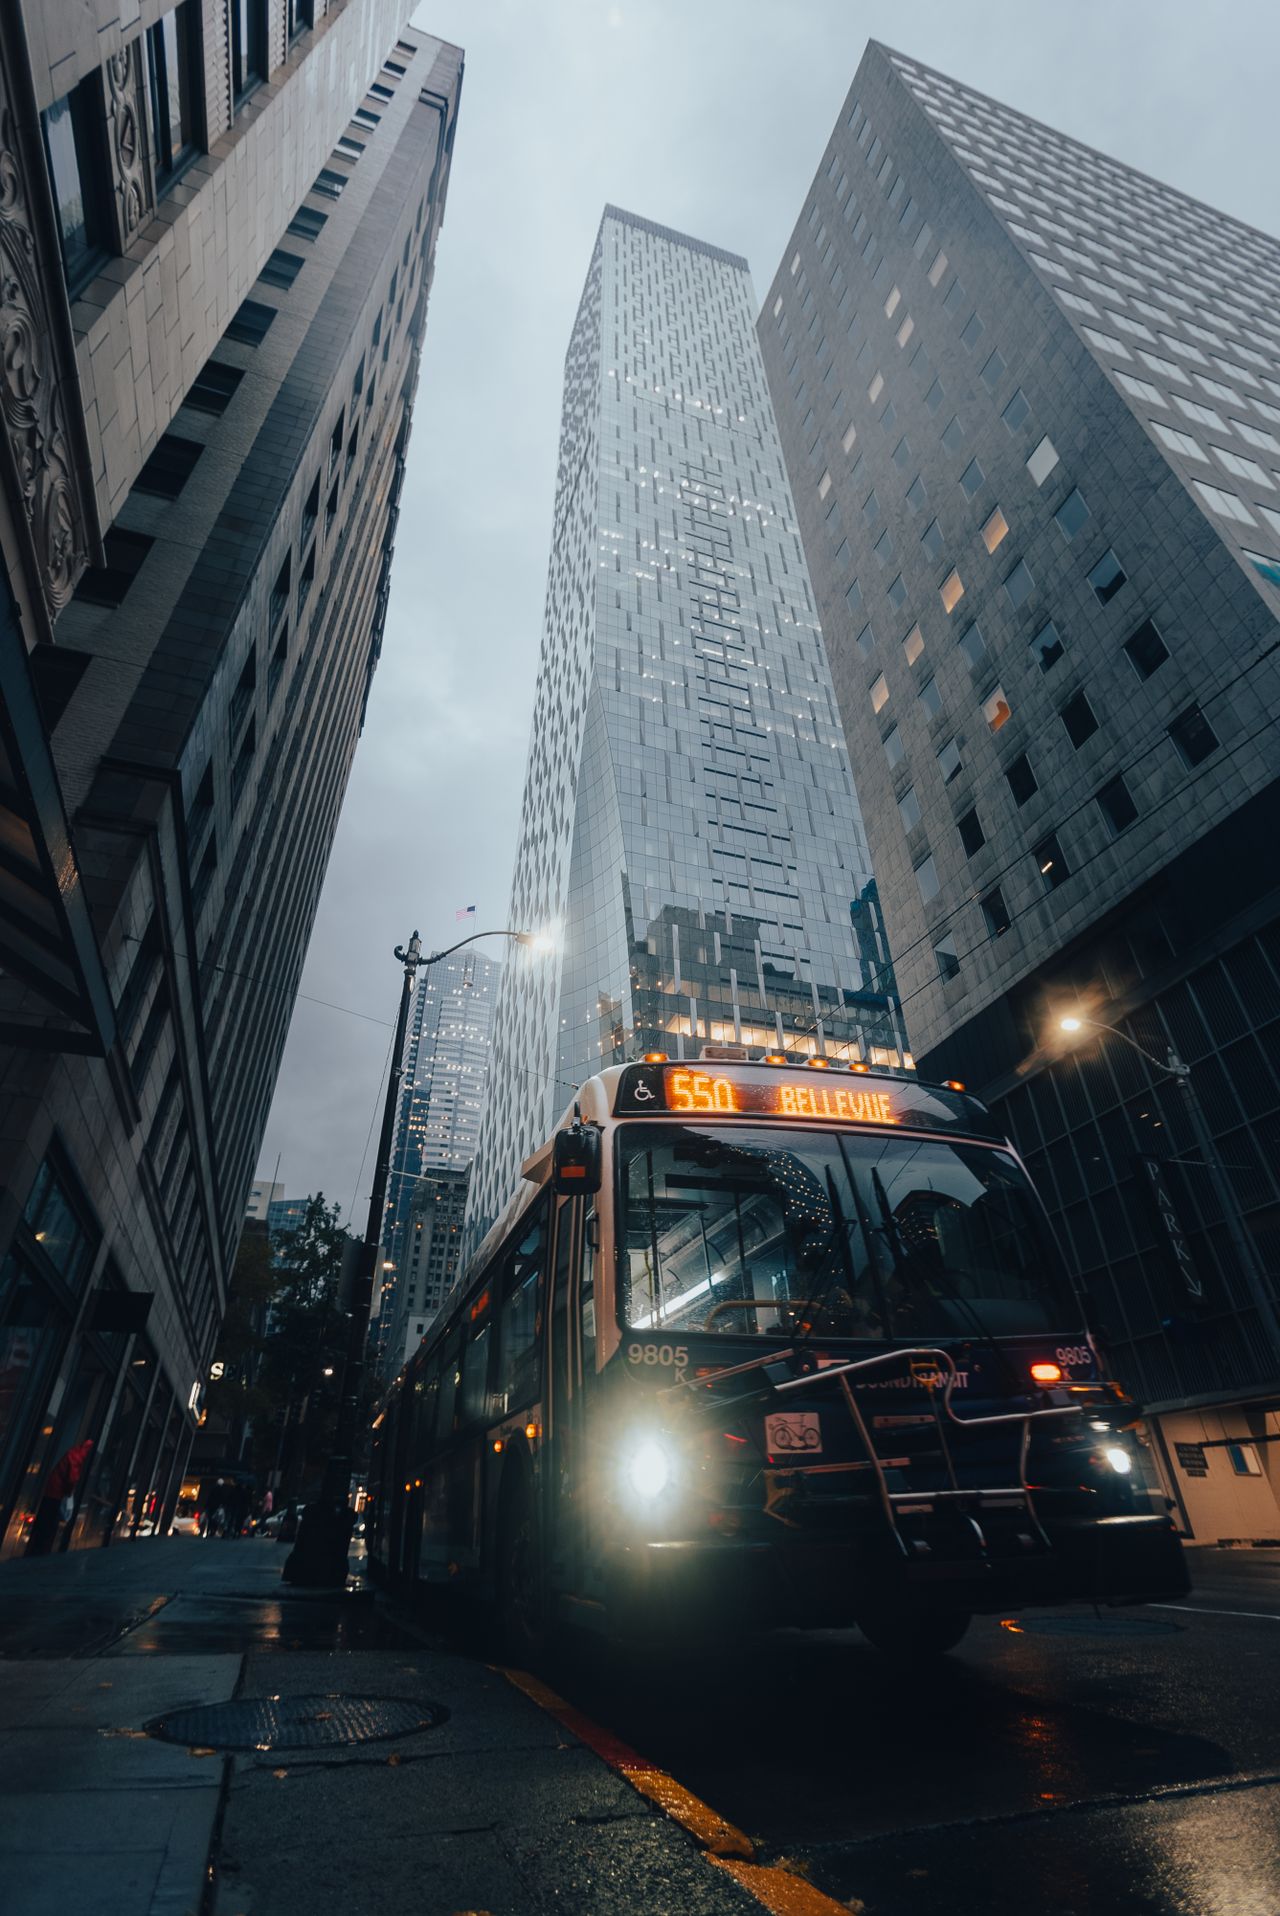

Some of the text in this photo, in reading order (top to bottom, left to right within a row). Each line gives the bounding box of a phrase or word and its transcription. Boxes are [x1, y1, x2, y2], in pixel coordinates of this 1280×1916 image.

[672, 1074, 895, 1123] 550 BELLEVUE
[1146, 1161, 1190, 1261] PARK
[628, 1343, 689, 1367] 9805
[1056, 1345, 1091, 1366] 9805
